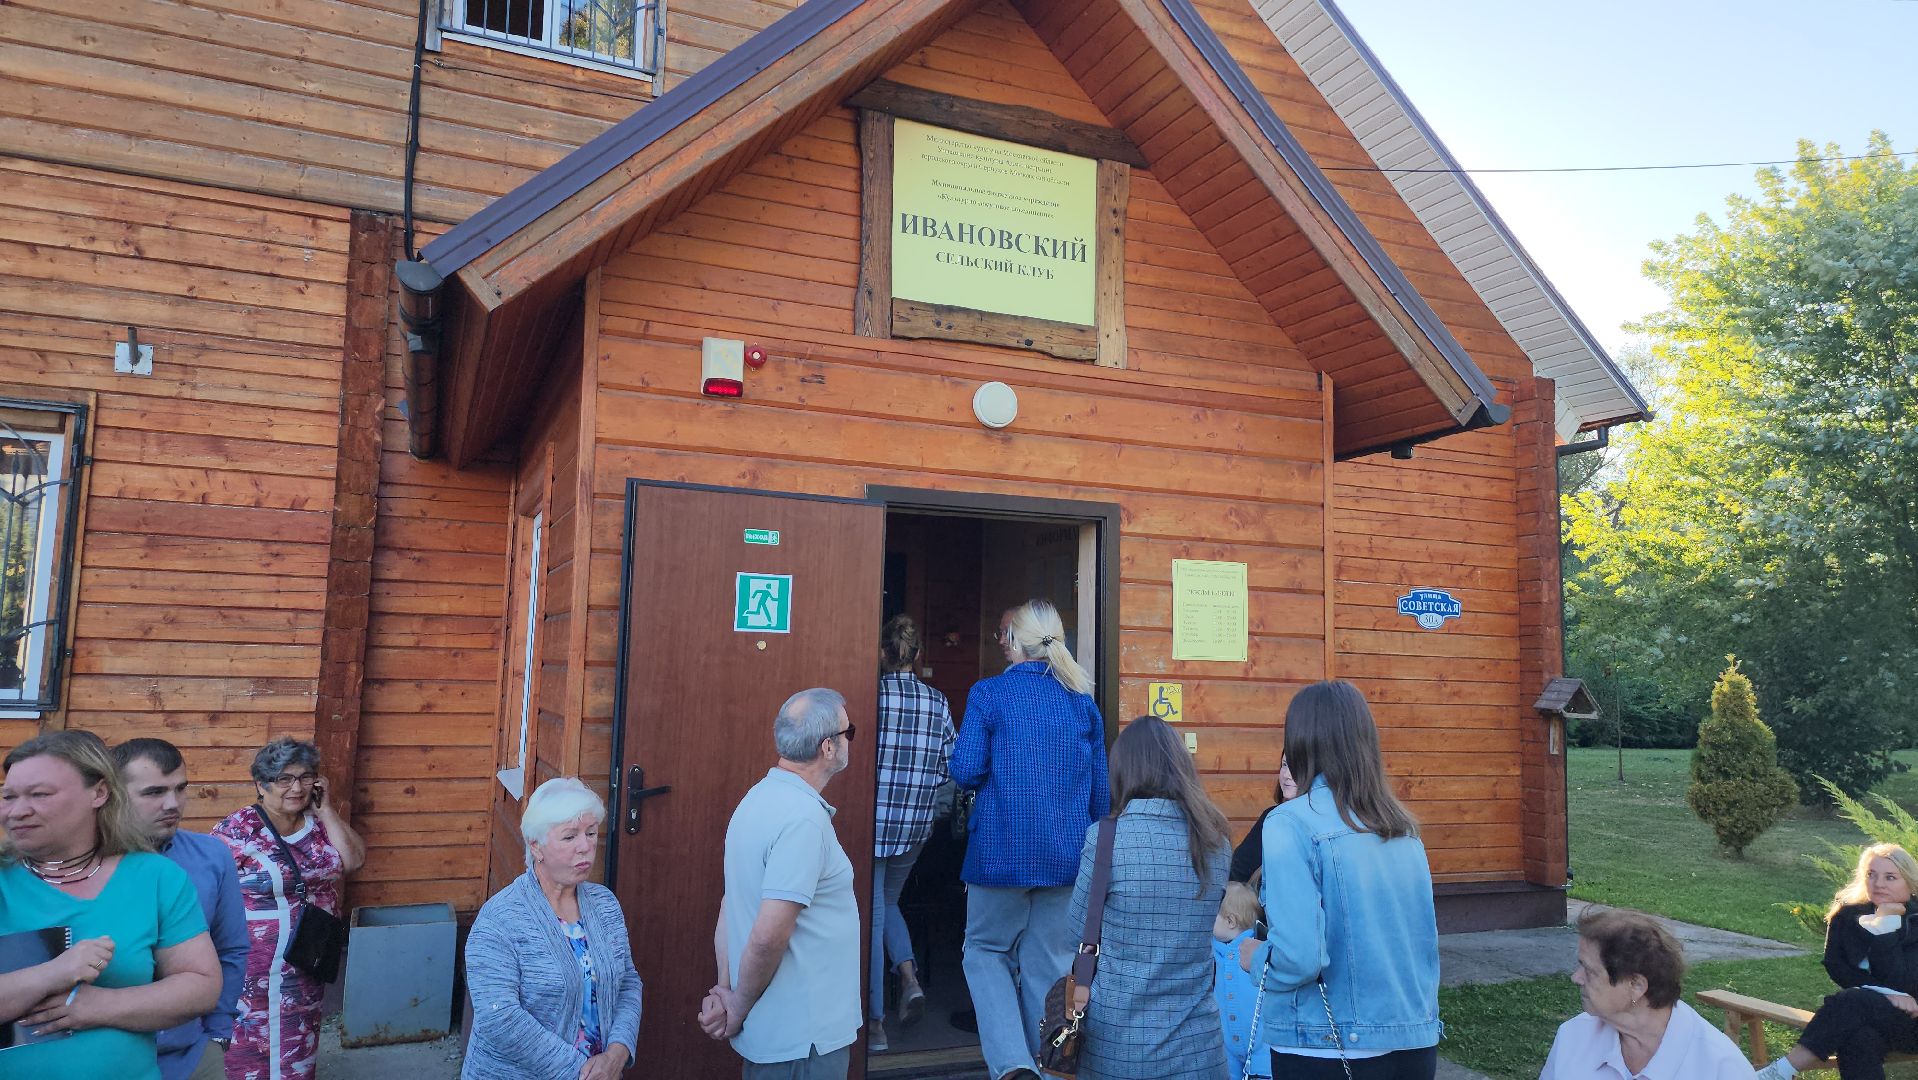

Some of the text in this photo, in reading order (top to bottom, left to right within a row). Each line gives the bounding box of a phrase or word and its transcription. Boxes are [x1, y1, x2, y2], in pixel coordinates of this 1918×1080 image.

[900, 212, 1088, 264] ИВАНОВСКИЙ
[935, 251, 1055, 281] СЕЛЬСКИЙ КЛУБ
[1401, 600, 1459, 613] СОВЕТСКАЯ
